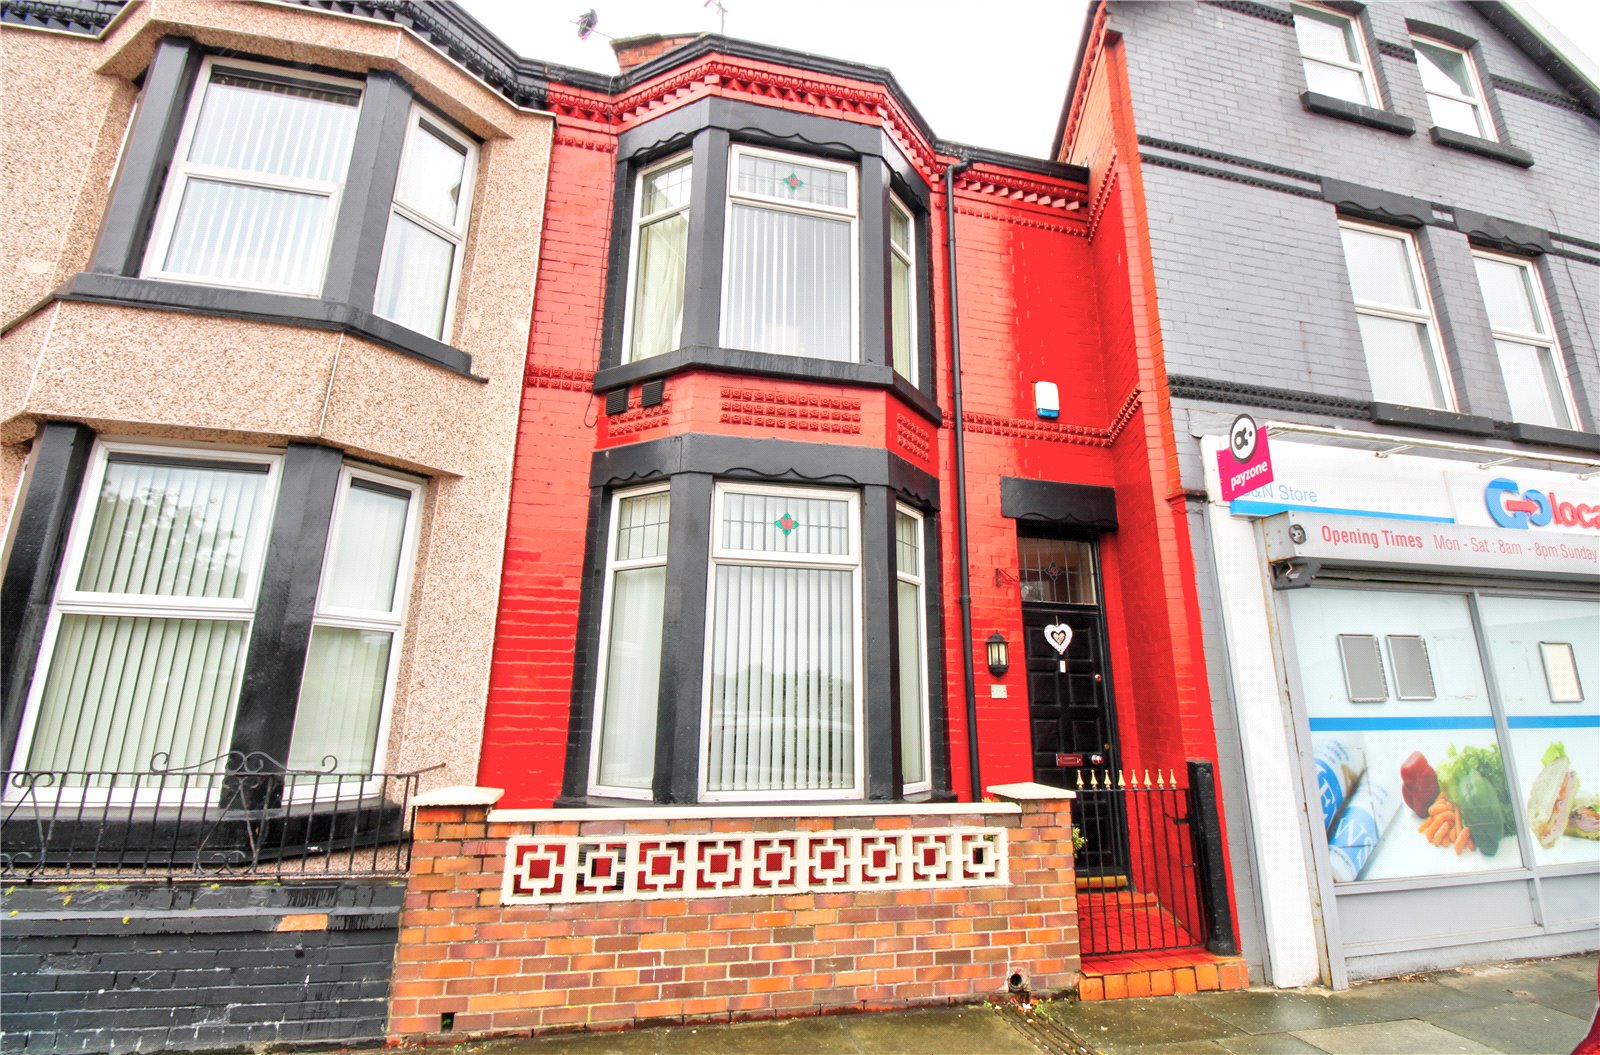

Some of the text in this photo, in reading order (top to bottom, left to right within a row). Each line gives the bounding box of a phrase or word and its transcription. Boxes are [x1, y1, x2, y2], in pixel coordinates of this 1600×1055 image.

[1230, 461, 1268, 491] payzone
[1278, 485, 1318, 502] Store
[1321, 525, 1379, 549] Opening
[1381, 530, 1424, 549] Times
[1433, 534, 1460, 551] Mon
[1470, 537, 1491, 553] Sat
[1498, 540, 1523, 555] 8am
[1535, 542, 1558, 559] 8pm
[1561, 544, 1598, 563] Sunday
